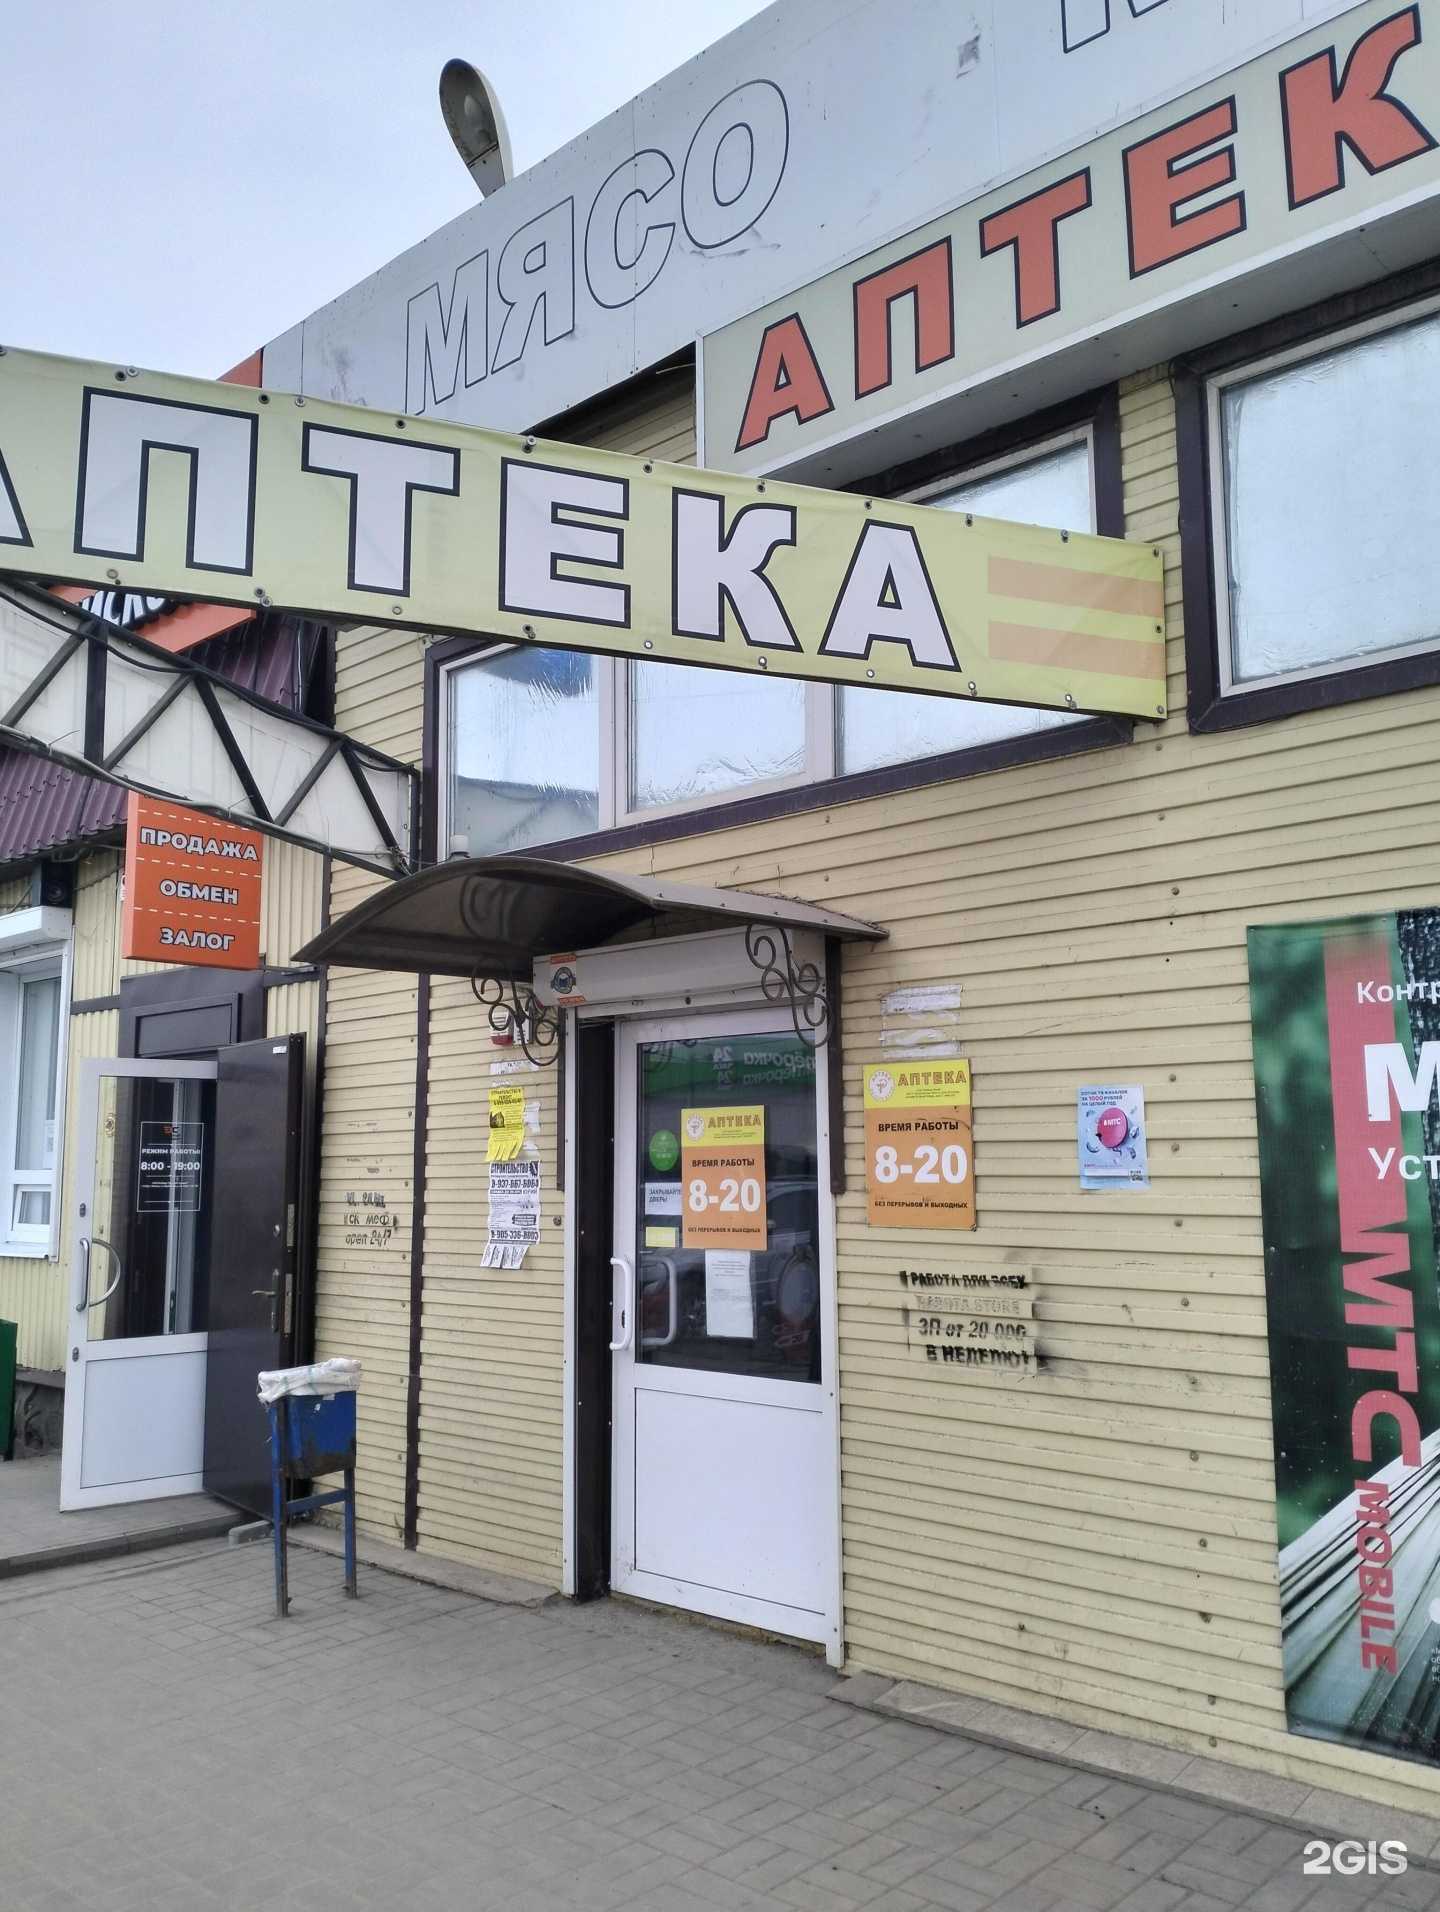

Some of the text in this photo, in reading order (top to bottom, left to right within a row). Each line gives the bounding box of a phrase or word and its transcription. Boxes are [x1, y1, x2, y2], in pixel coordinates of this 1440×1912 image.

[405, 79, 790, 417] МЯСО
[0, 386, 957, 671] ПТЕКА
[140, 826, 258, 861] ПРОДАЖА
[160, 879, 239, 905] ОБМЕН
[160, 927, 235, 950] ЗАЛОГ
[897, 1070, 967, 1087] АПТЕКА
[708, 1114, 762, 1129] АПТЕКА
[878, 1121, 959, 1132] ВРЕМЯ РАБОТЫ
[692, 1158, 755, 1168] ВРЕМЯ РАБОТЫ
[874, 1144, 968, 1184] 8-20
[688, 1178, 761, 1212] 8-20
[910, 1271, 960, 1288] РАБОТА
[918, 1317, 941, 1337] ЗП
[926, 1344, 937, 1361] В
[1354, 1478, 1400, 1676] MOBILE
